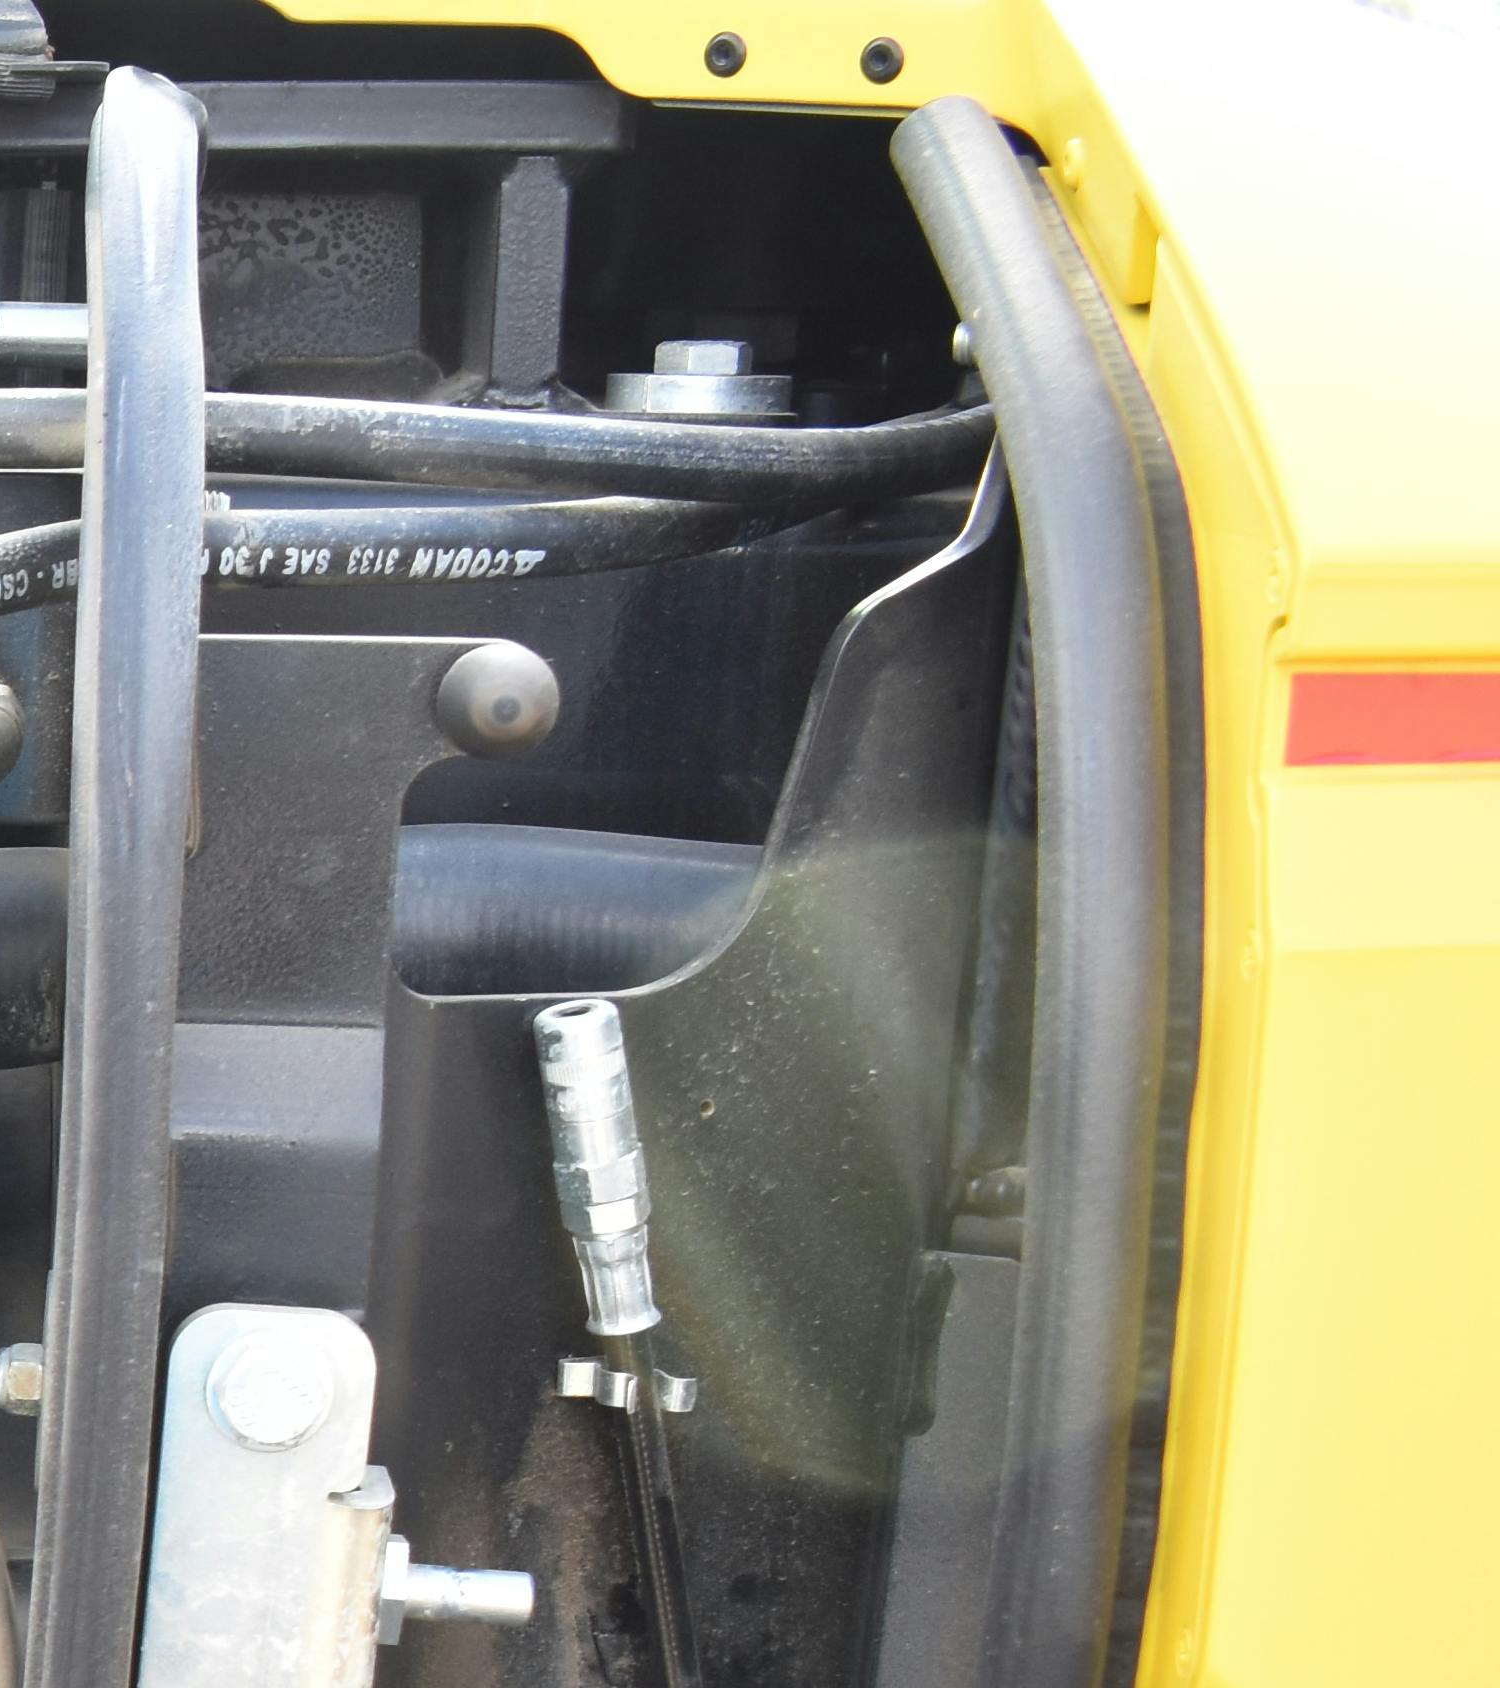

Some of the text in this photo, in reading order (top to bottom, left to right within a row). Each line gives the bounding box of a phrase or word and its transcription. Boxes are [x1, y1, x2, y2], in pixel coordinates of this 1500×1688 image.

[52, 558, 79, 590] BR
[282, 547, 332, 576] SAE
[346, 547, 400, 576] 3133
